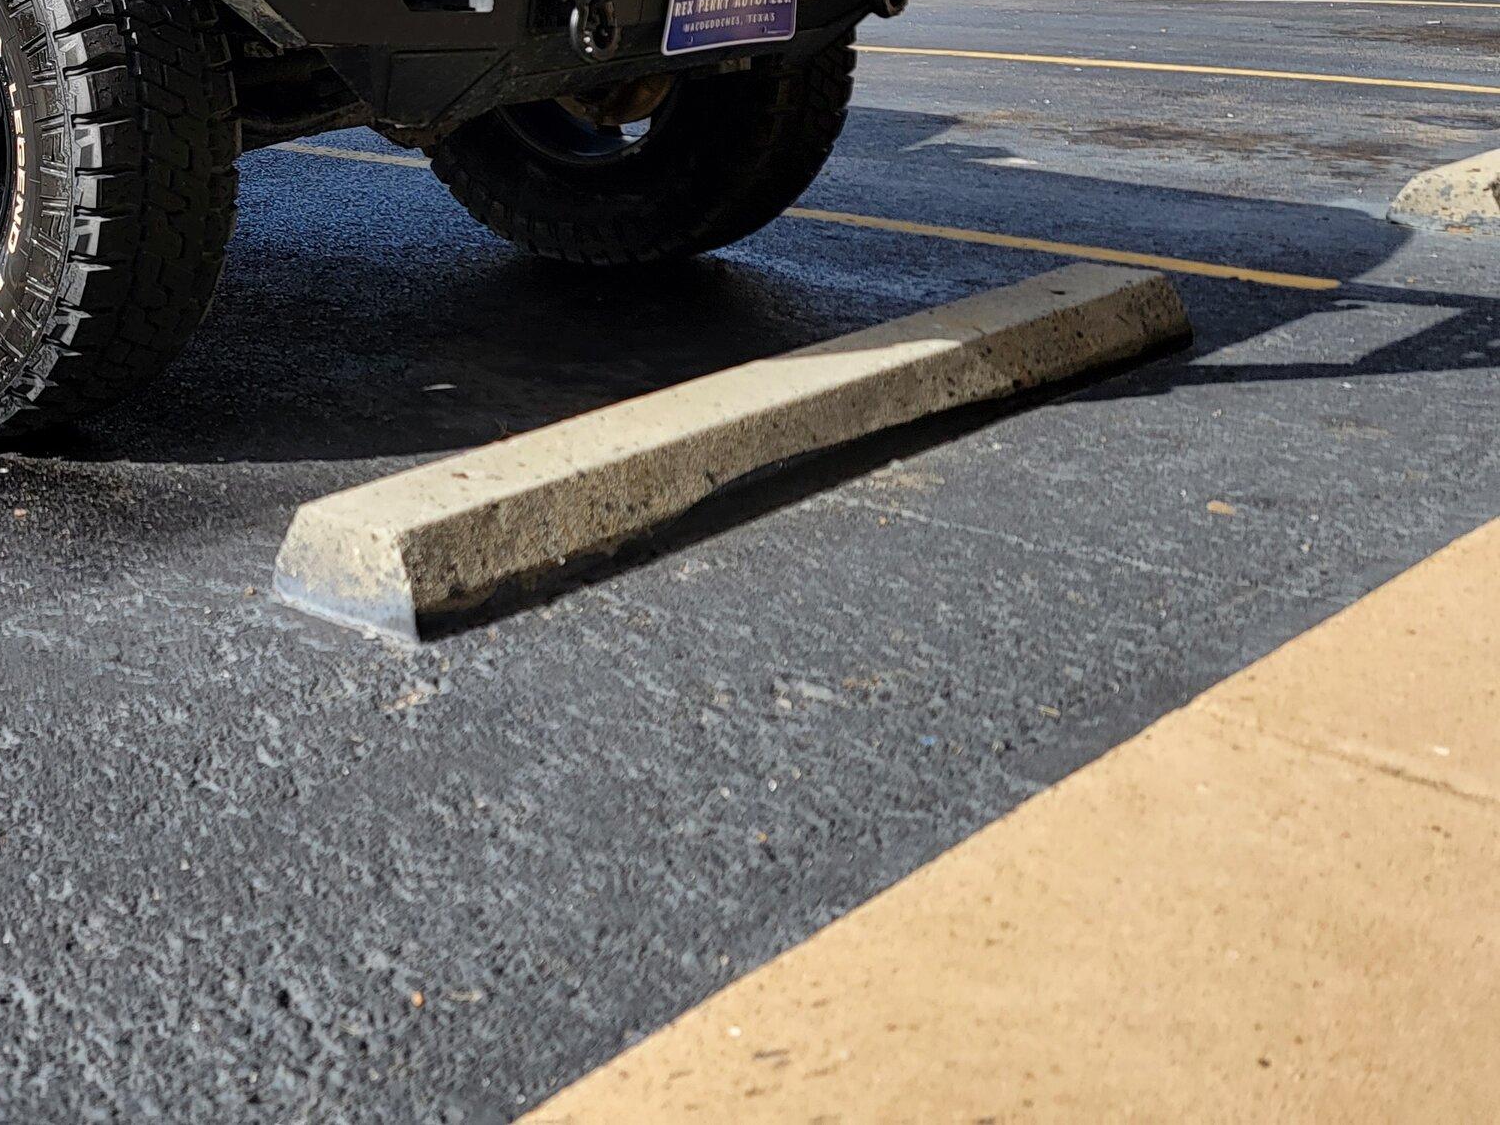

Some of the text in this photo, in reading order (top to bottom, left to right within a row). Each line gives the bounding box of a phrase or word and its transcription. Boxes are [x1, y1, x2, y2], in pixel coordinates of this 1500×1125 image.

[674, 0, 694, 17] REX
[748, 12, 775, 23] TEXAS
[8, 82, 27, 255] LEGEND
